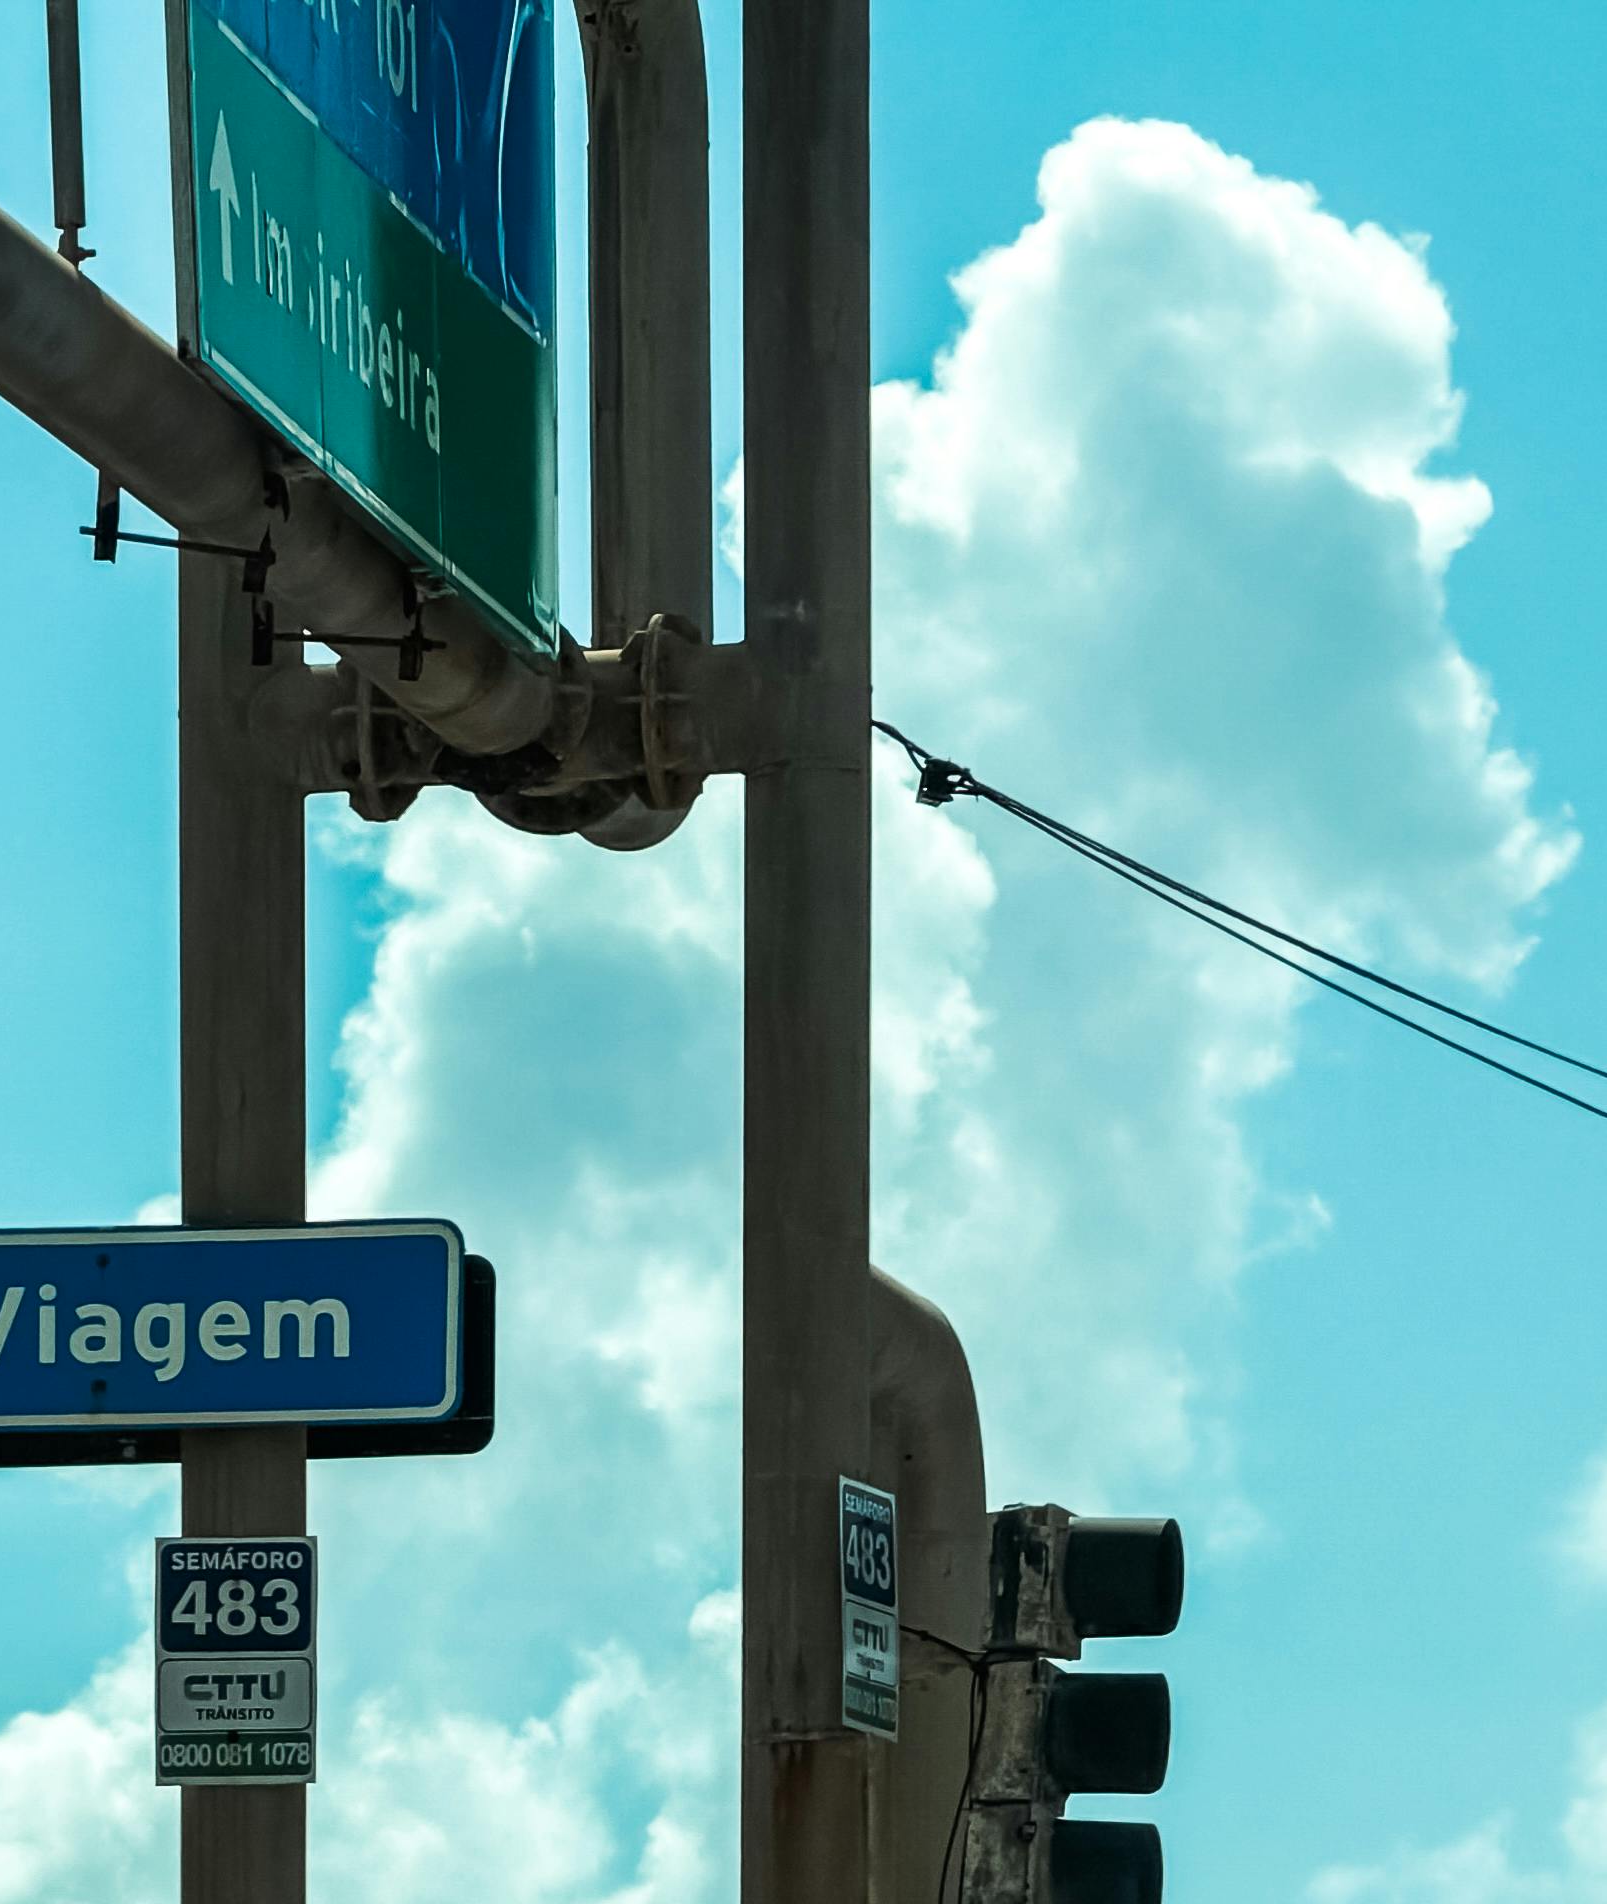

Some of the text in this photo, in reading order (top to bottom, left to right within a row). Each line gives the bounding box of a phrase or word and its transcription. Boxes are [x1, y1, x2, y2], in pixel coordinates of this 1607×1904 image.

[251, 171, 441, 455] Imiribeira
[171, 1547, 303, 1571] SEMÁFORO
[846, 1524, 891, 1590] 483
[171, 1578, 300, 1636] 483
[183, 1670, 286, 1701] CTTU
[196, 1705, 275, 1721] TRÂNSITO
[161, 1742, 310, 1767] 0800 081 1078
